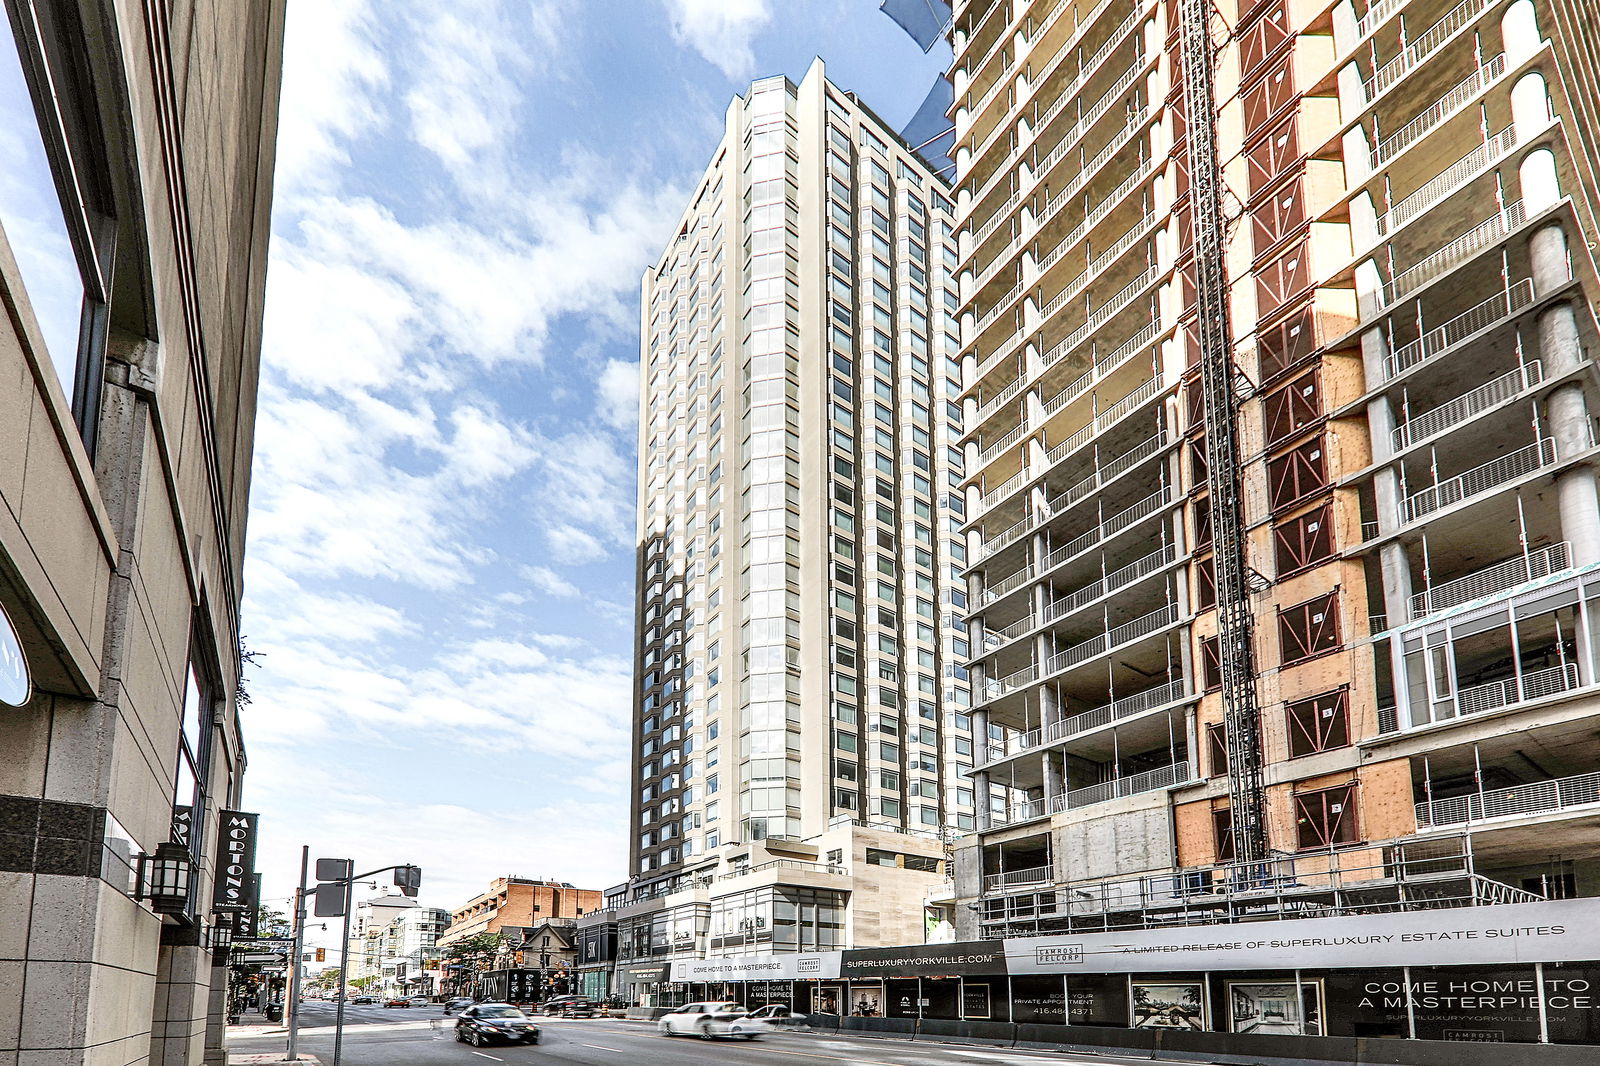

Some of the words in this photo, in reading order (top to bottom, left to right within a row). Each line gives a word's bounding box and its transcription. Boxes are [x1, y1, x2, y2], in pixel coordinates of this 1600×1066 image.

[1134, 945, 1179, 954] LIMITED
[1183, 942, 1242, 952] RELEASE
[1246, 940, 1267, 949] OF
[1270, 934, 1394, 948] SUPERLUXURY
[1401, 930, 1479, 943] ESTATE
[1485, 925, 1566, 938] SUITES
[1039, 947, 1079, 955] CAMROST
[847, 954, 993, 968] SUPERLUXURYYORKVILLE.COM
[1039, 954, 1079, 962] FELCORP
[738, 962, 783, 971] MASTERPIECE.
[1364, 981, 1439, 994] COME
[1449, 980, 1535, 993] HOME
[1545, 979, 1590, 992] TO
[1358, 997, 1374, 1008] A
[1384, 996, 1600, 1009] MASTERPIECE.
